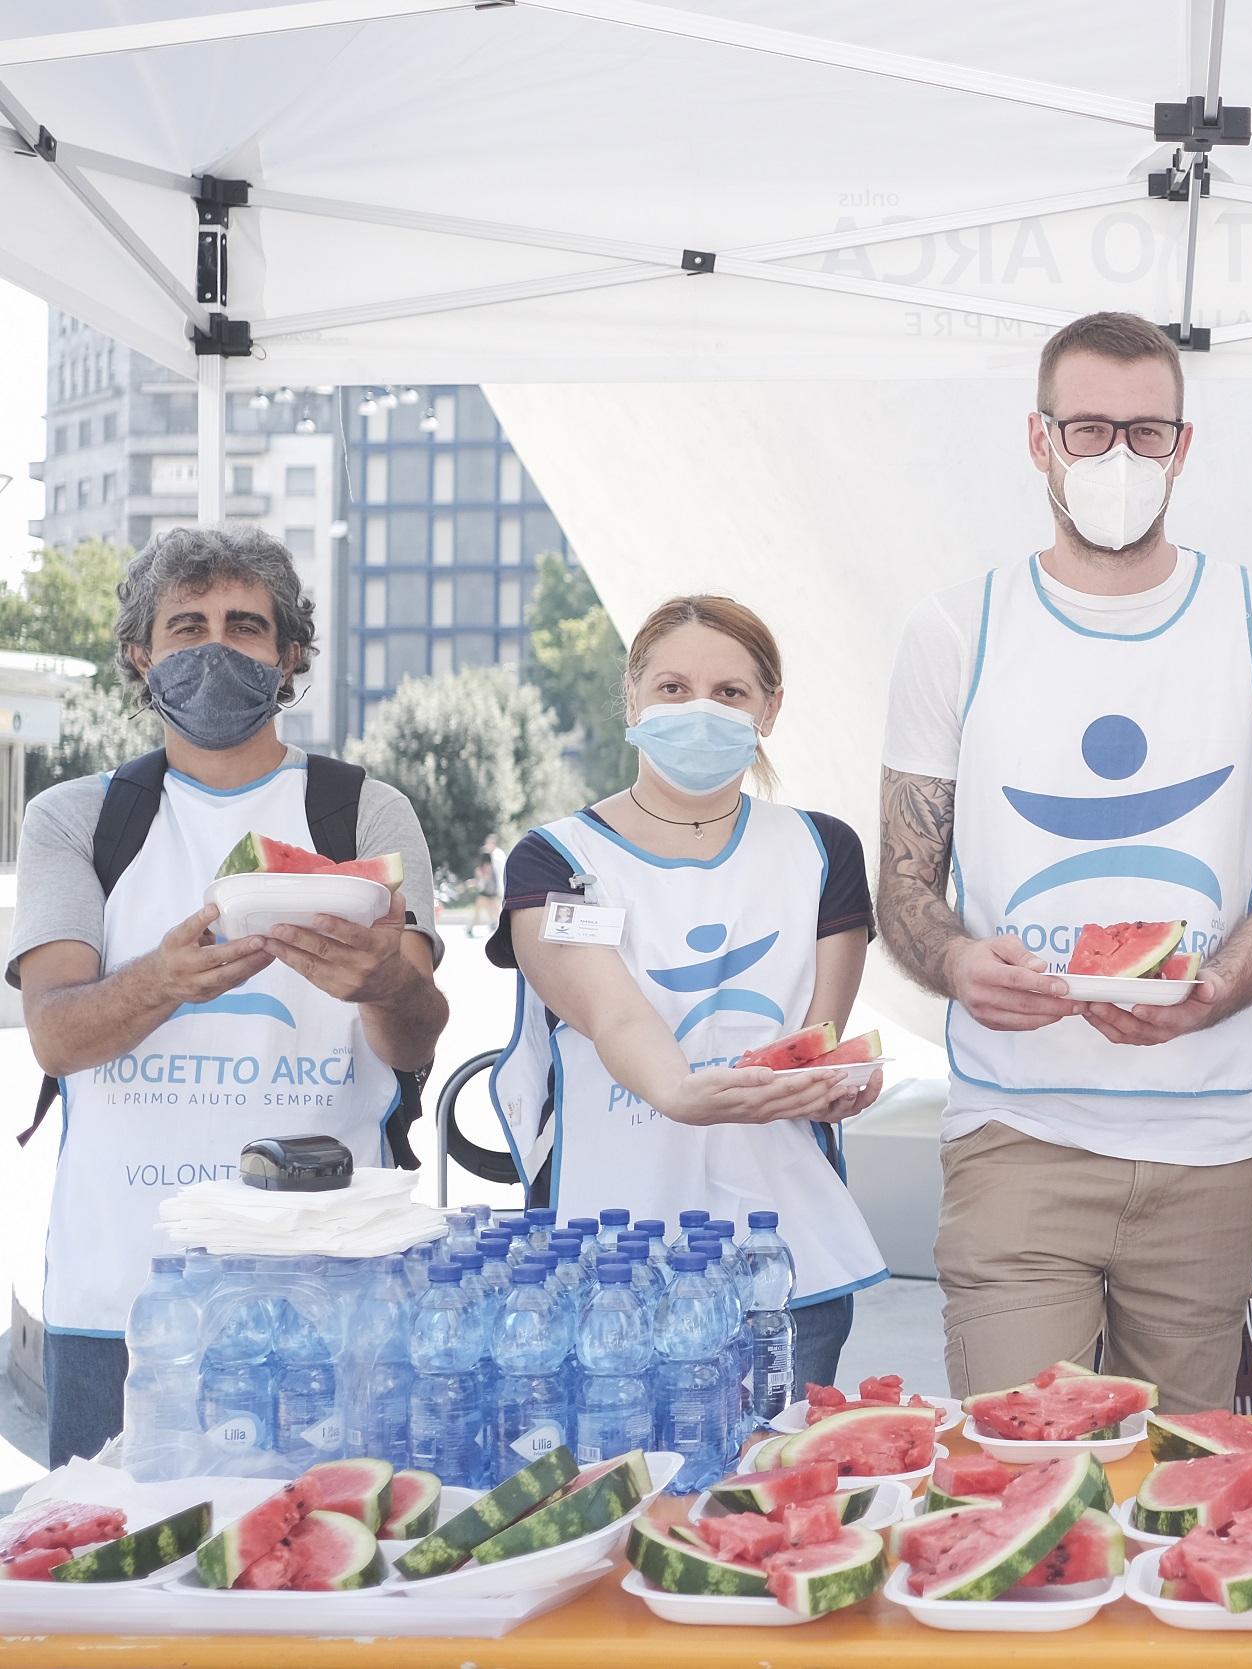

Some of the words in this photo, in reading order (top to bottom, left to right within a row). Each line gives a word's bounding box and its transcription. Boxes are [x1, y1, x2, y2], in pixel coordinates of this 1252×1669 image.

[332, 1046, 354, 1056] onlu
[93, 1053, 260, 1085] PROGETTO
[271, 1055, 355, 1086] ARCA
[107, 1093, 118, 1105] IL
[124, 1092, 178, 1105] PRIMO
[188, 1093, 247, 1106] AIUTO
[264, 1093, 334, 1107] SEMPRE
[126, 1163, 237, 1186] VOLONT
[224, 1428, 246, 1441] Lilia
[532, 1438, 552, 1451] Lilia
